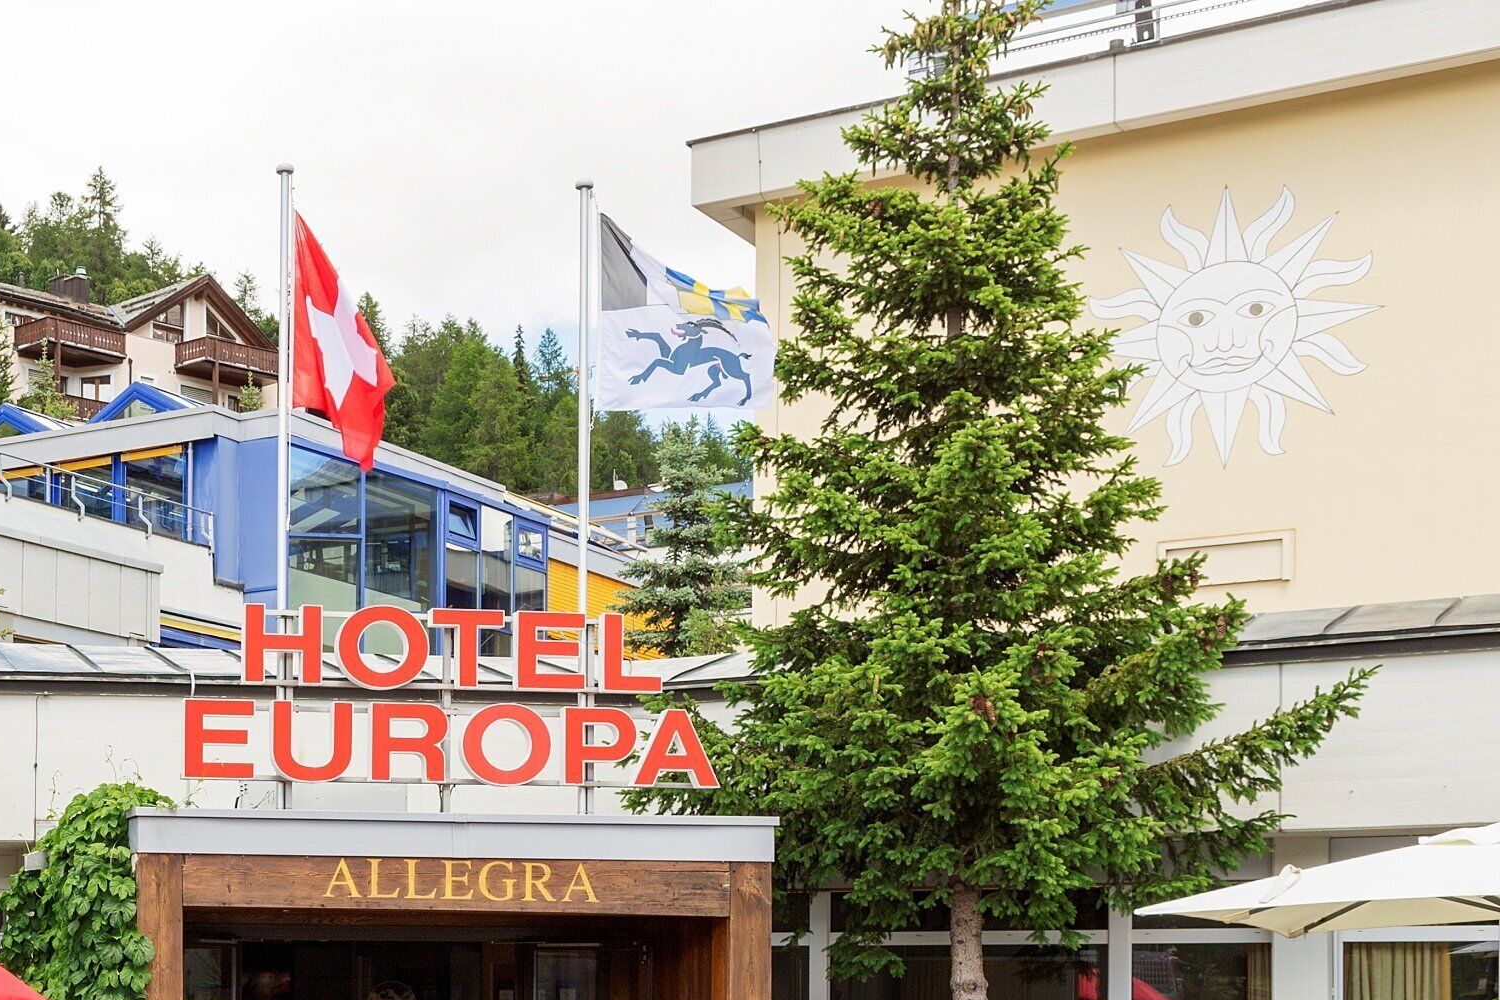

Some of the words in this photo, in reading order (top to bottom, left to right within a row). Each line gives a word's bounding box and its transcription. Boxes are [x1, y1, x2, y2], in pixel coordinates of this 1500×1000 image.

[241, 602, 662, 693] HOTEL
[181, 698, 720, 789] EUROPA
[323, 858, 600, 902] ALLEGRA
